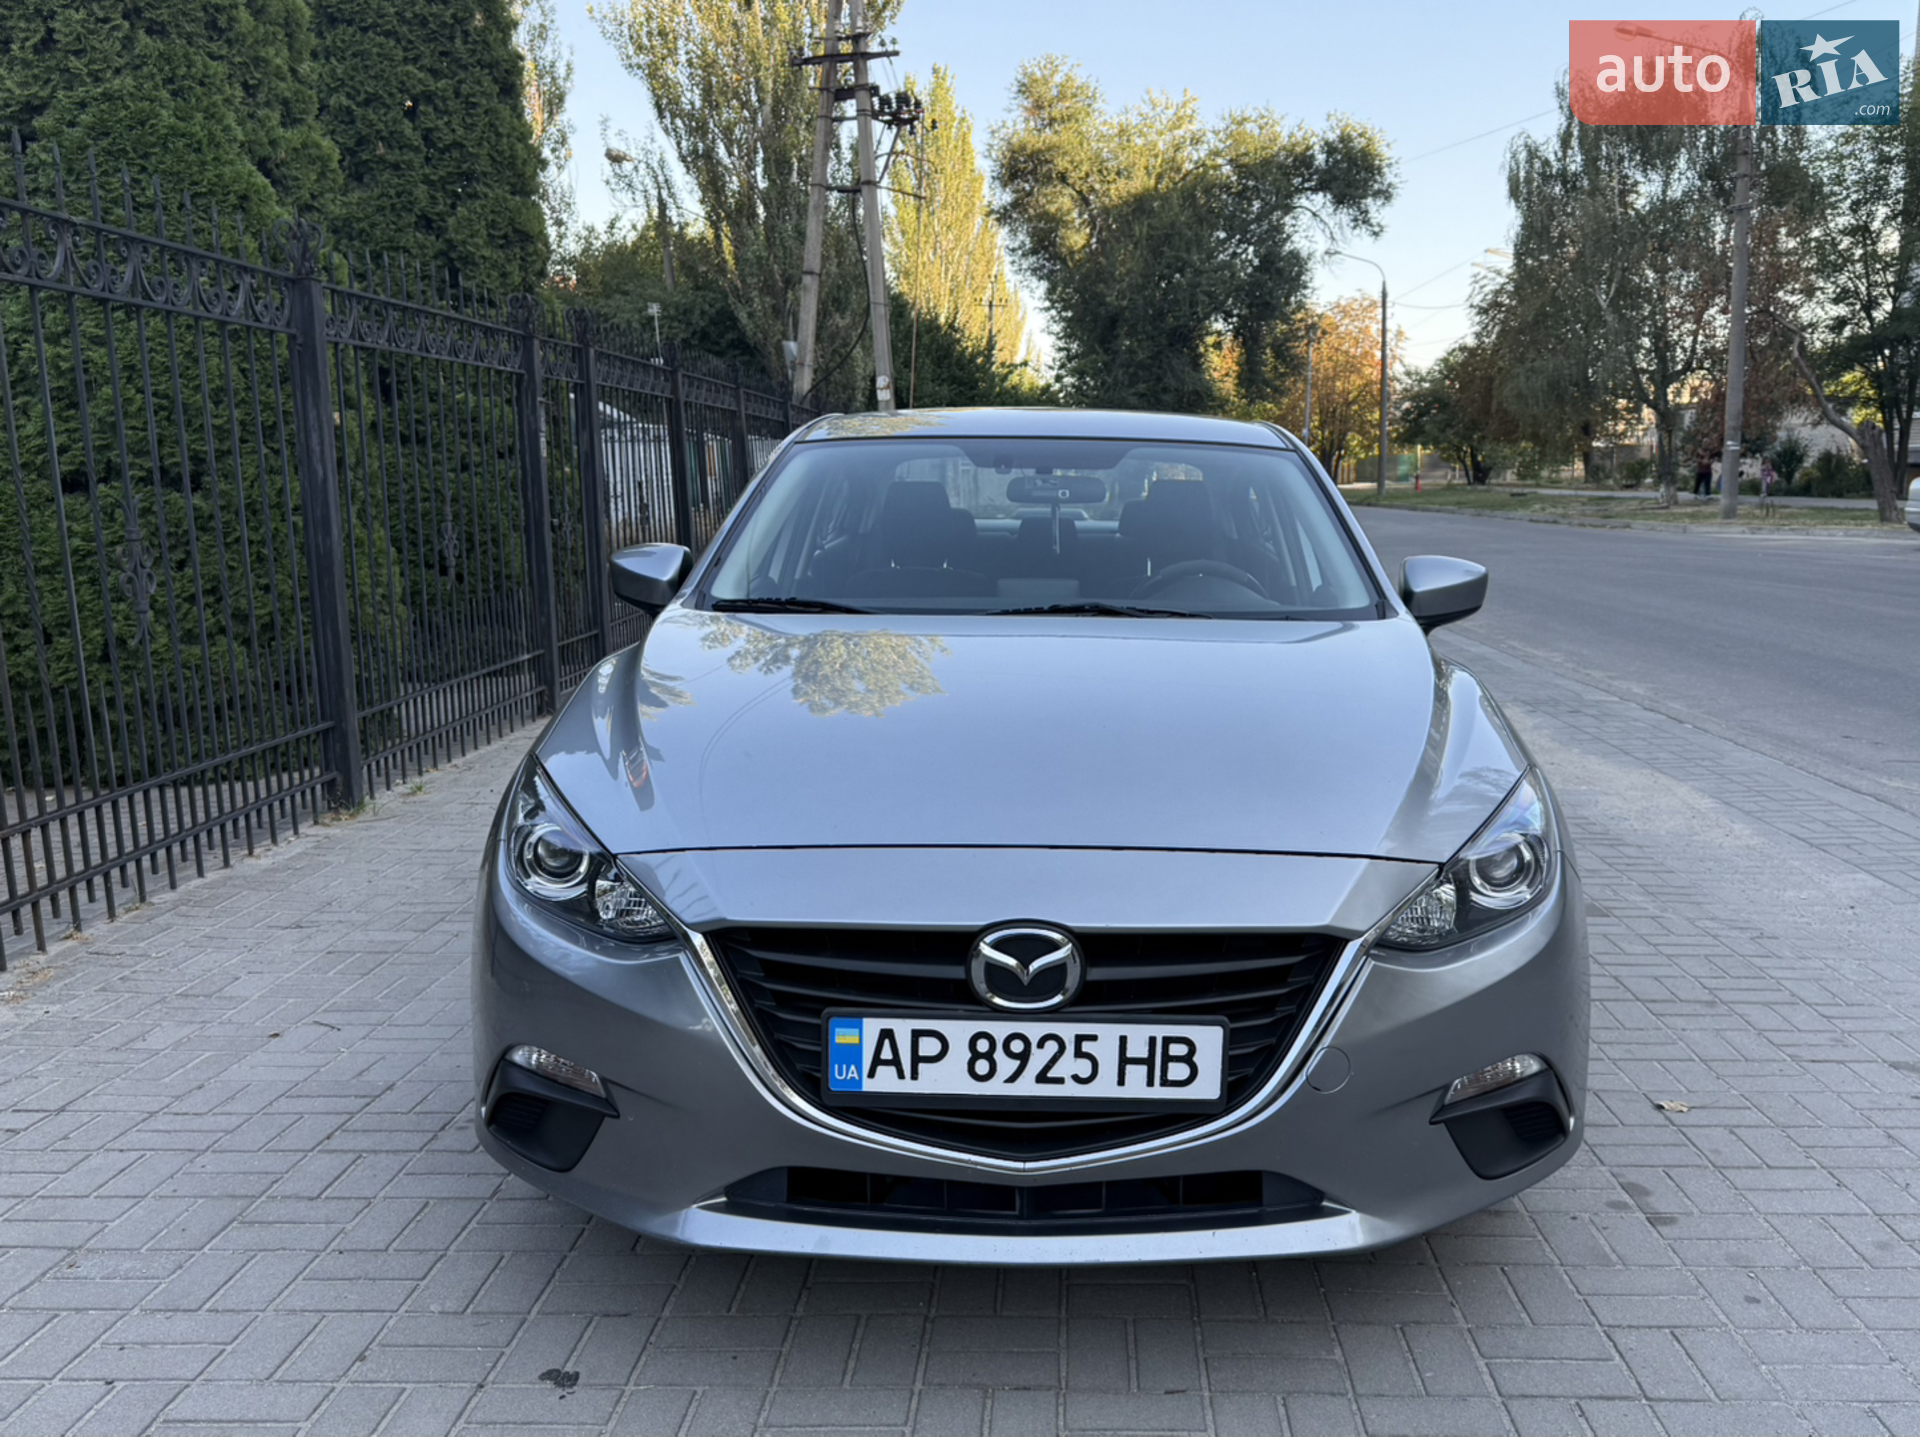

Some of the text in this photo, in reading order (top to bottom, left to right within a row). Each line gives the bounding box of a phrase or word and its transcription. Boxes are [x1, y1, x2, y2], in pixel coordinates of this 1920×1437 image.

[835, 1064, 860, 1081] UA
[867, 1027, 1200, 1088] AP 8925 HB
